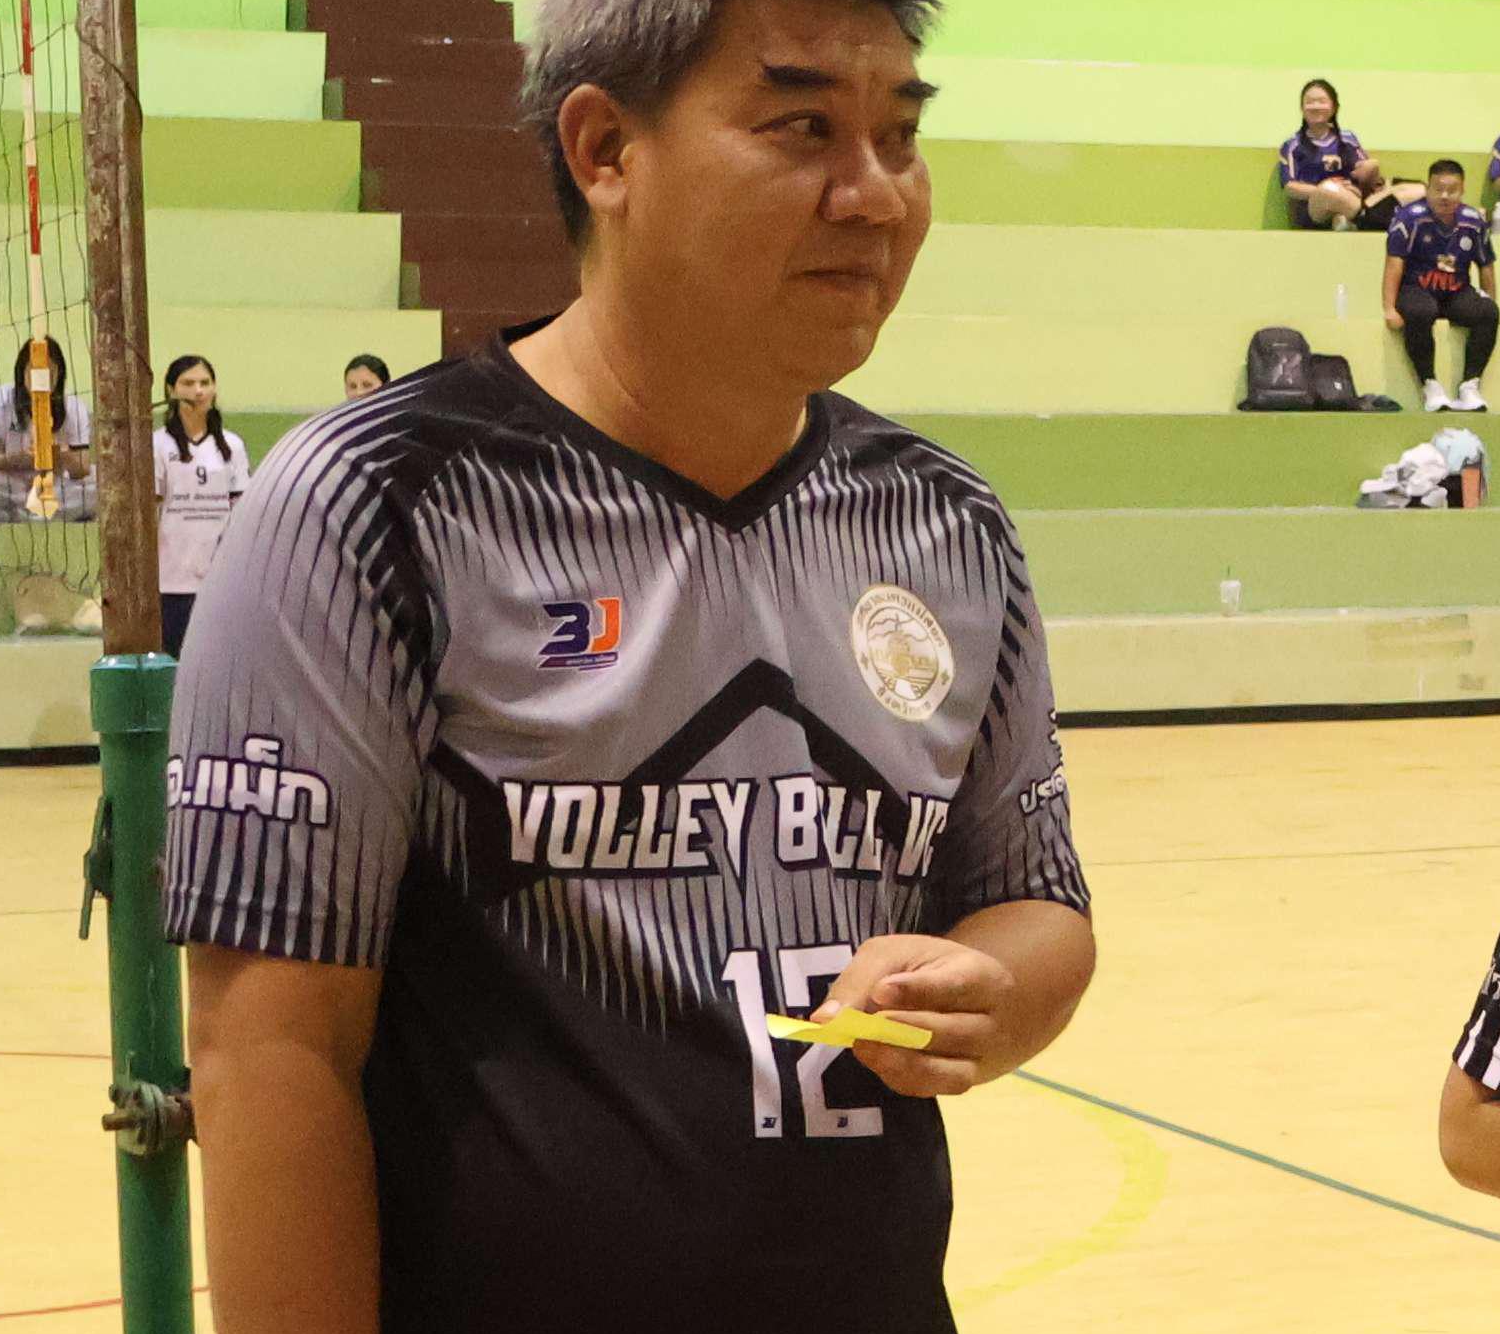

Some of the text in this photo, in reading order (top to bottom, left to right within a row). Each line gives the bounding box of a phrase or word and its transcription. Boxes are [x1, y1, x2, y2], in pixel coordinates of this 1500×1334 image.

[502, 779, 750, 882] VOLLEY
[774, 775, 883, 873] BLL
[720, 942, 884, 1138] 12
